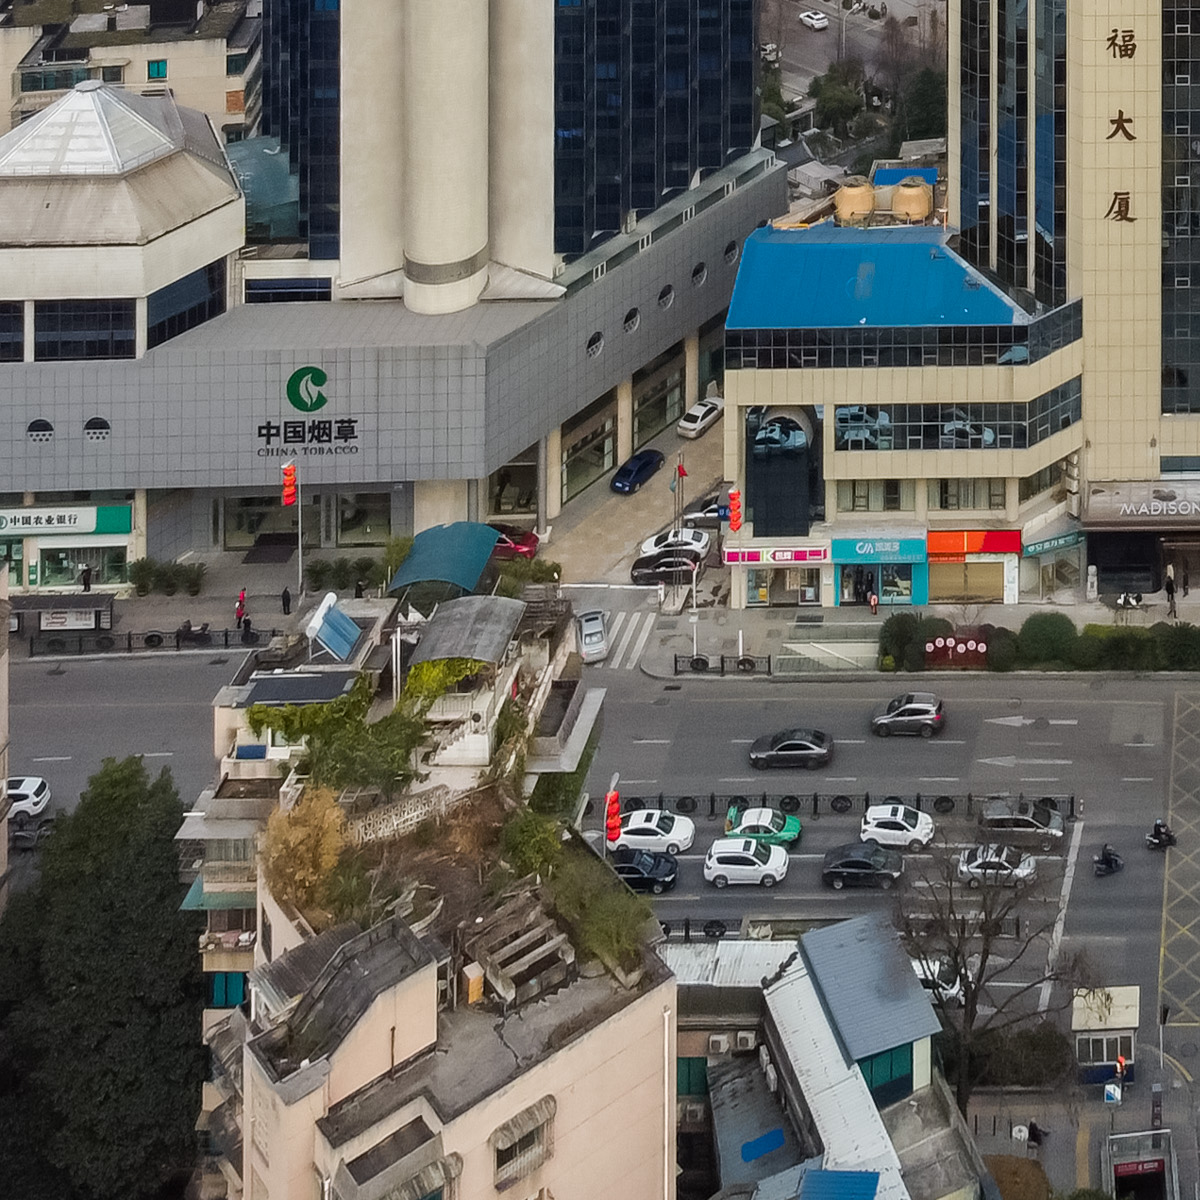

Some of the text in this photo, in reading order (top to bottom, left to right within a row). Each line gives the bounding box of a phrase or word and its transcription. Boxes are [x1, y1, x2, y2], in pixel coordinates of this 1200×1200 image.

[257, 418, 359, 445] 中国烟草
[257, 445, 359, 457] CHINA TOBACCO
[10, 514, 78, 526] 中国农业银行
